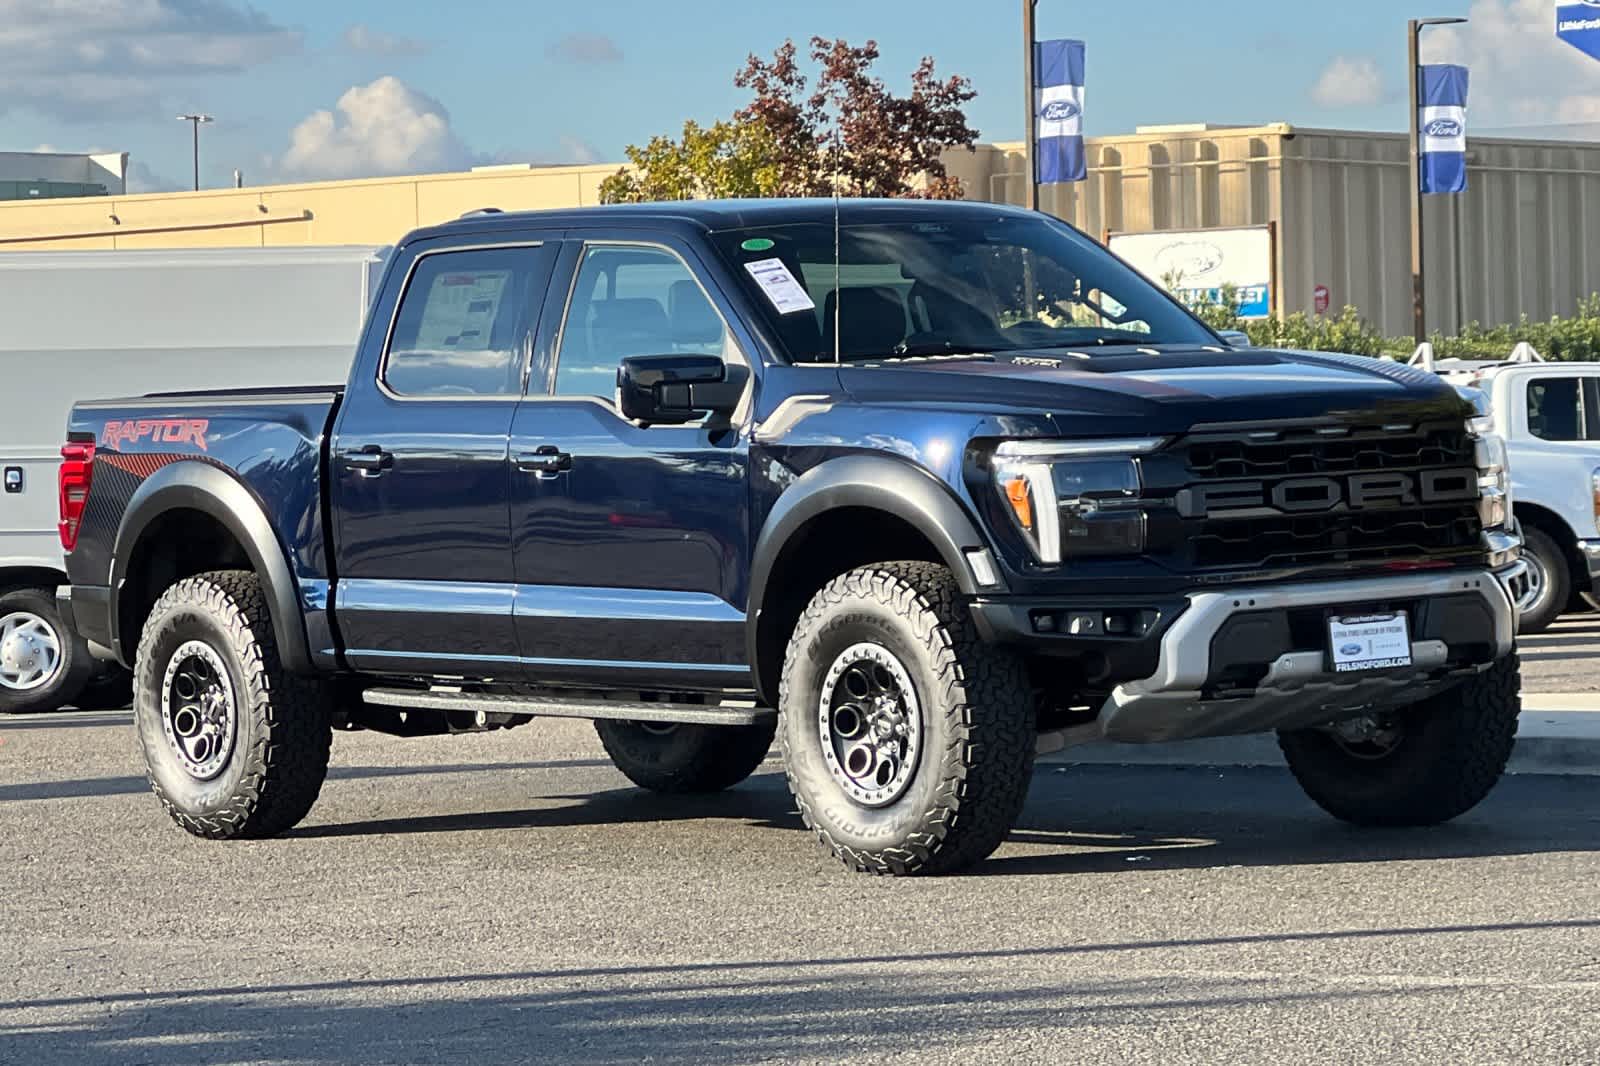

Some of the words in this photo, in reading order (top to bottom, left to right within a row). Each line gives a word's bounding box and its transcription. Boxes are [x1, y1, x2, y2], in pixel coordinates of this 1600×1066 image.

[1429, 121, 1459, 136] Ford
[101, 419, 209, 452] RAPTOR
[1175, 468, 1480, 519] FORD
[1336, 657, 1411, 672] FRESNOFORD.COM
